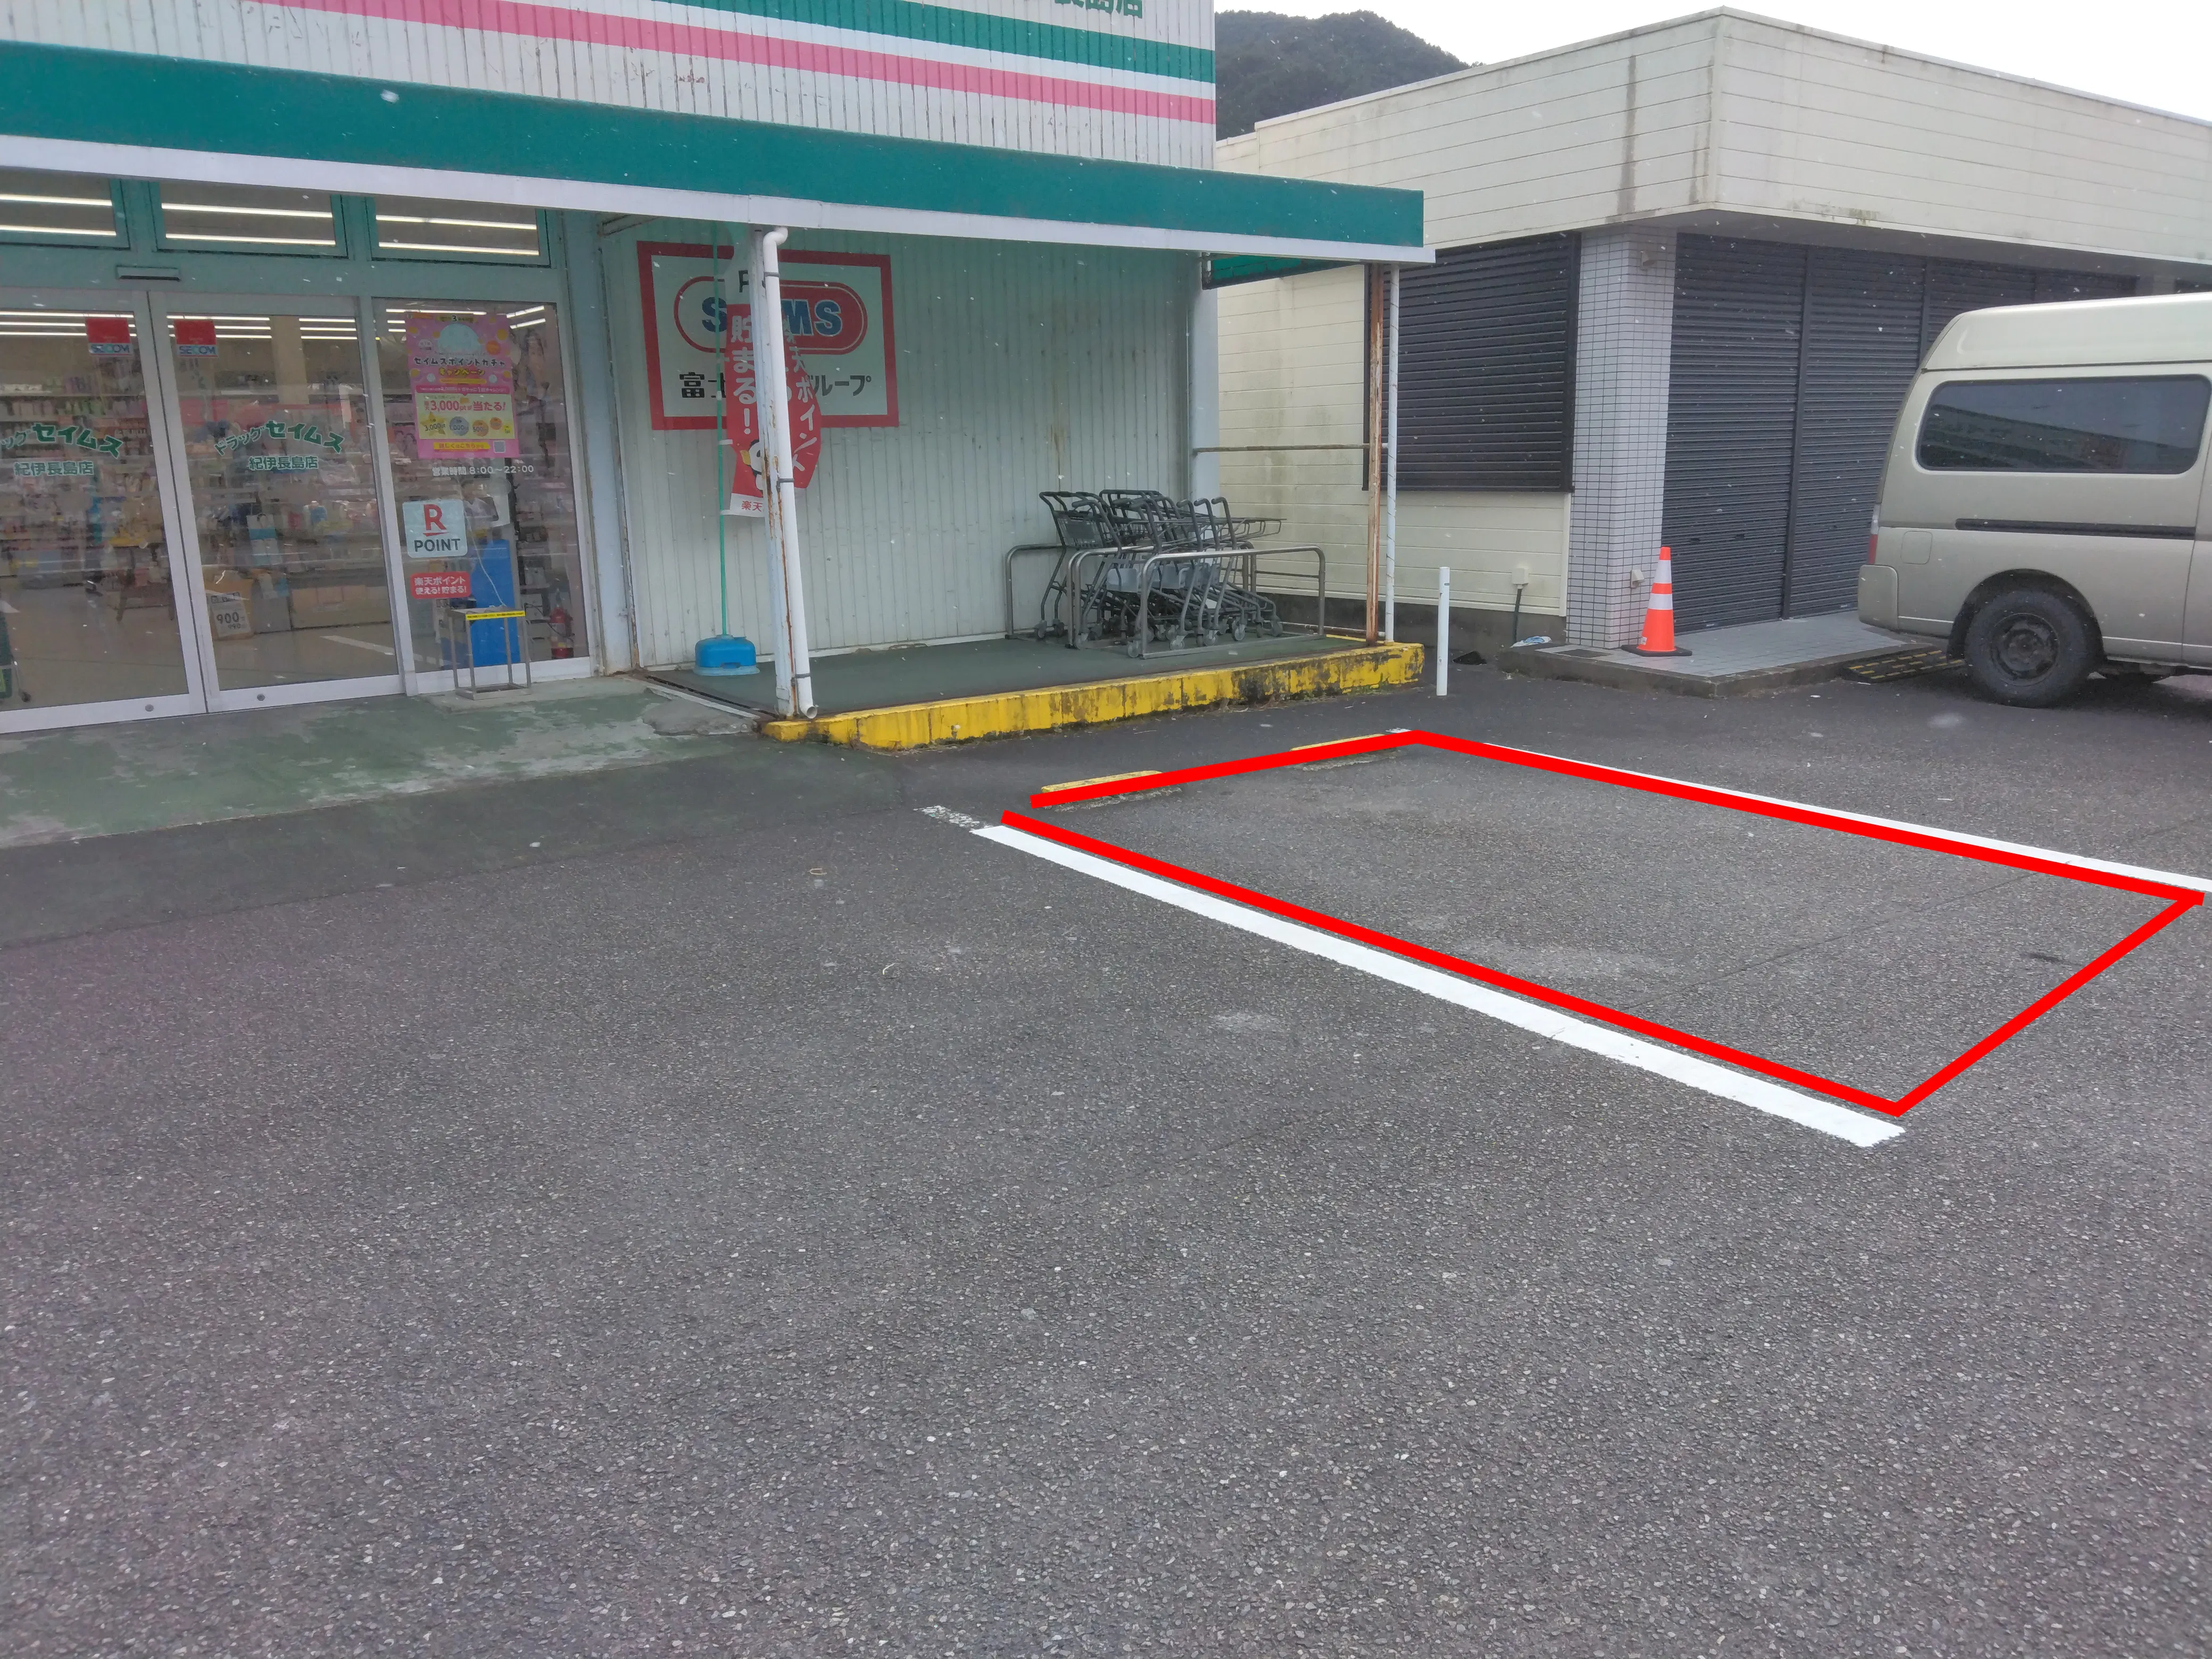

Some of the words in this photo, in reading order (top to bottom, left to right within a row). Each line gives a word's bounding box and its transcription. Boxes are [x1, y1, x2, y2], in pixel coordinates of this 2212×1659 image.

[91, 344, 130, 354] SECOM
[179, 346, 216, 355] SECOM
[14, 461, 94, 476] 紀伊長島店
[249, 456, 319, 470] 紀伊長島店
[432, 466, 467, 476] 営業時間
[423, 504, 447, 531] R
[414, 538, 461, 552] POINT
[414, 576, 466, 585] 楽天ポイント
[216, 611, 239, 624] 900
